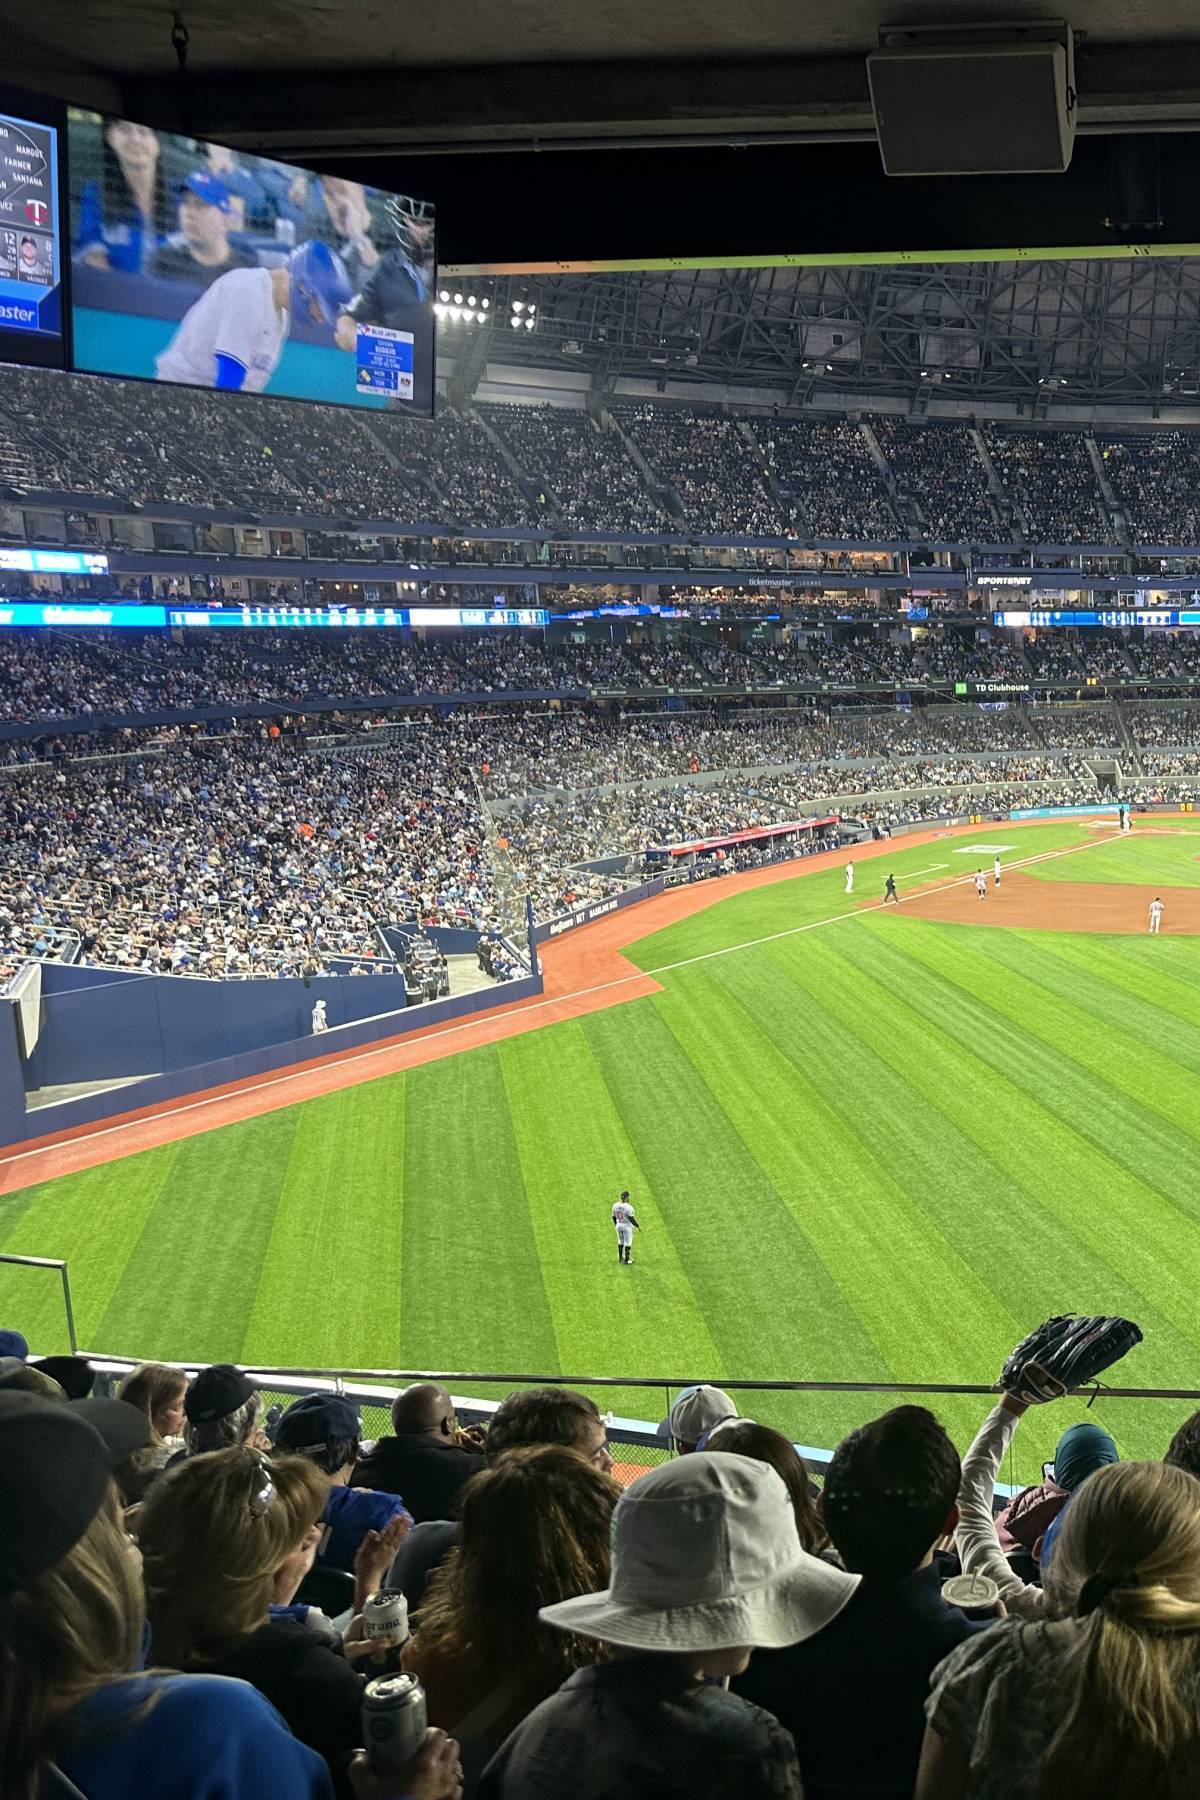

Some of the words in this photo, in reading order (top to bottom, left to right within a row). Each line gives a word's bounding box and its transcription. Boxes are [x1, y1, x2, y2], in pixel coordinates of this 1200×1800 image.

[748, 577, 792, 587] ticketmaster
[977, 576, 1032, 585] SPORTSNET
[975, 684, 987, 692] TD
[988, 683, 1030, 692] Clubhouse
